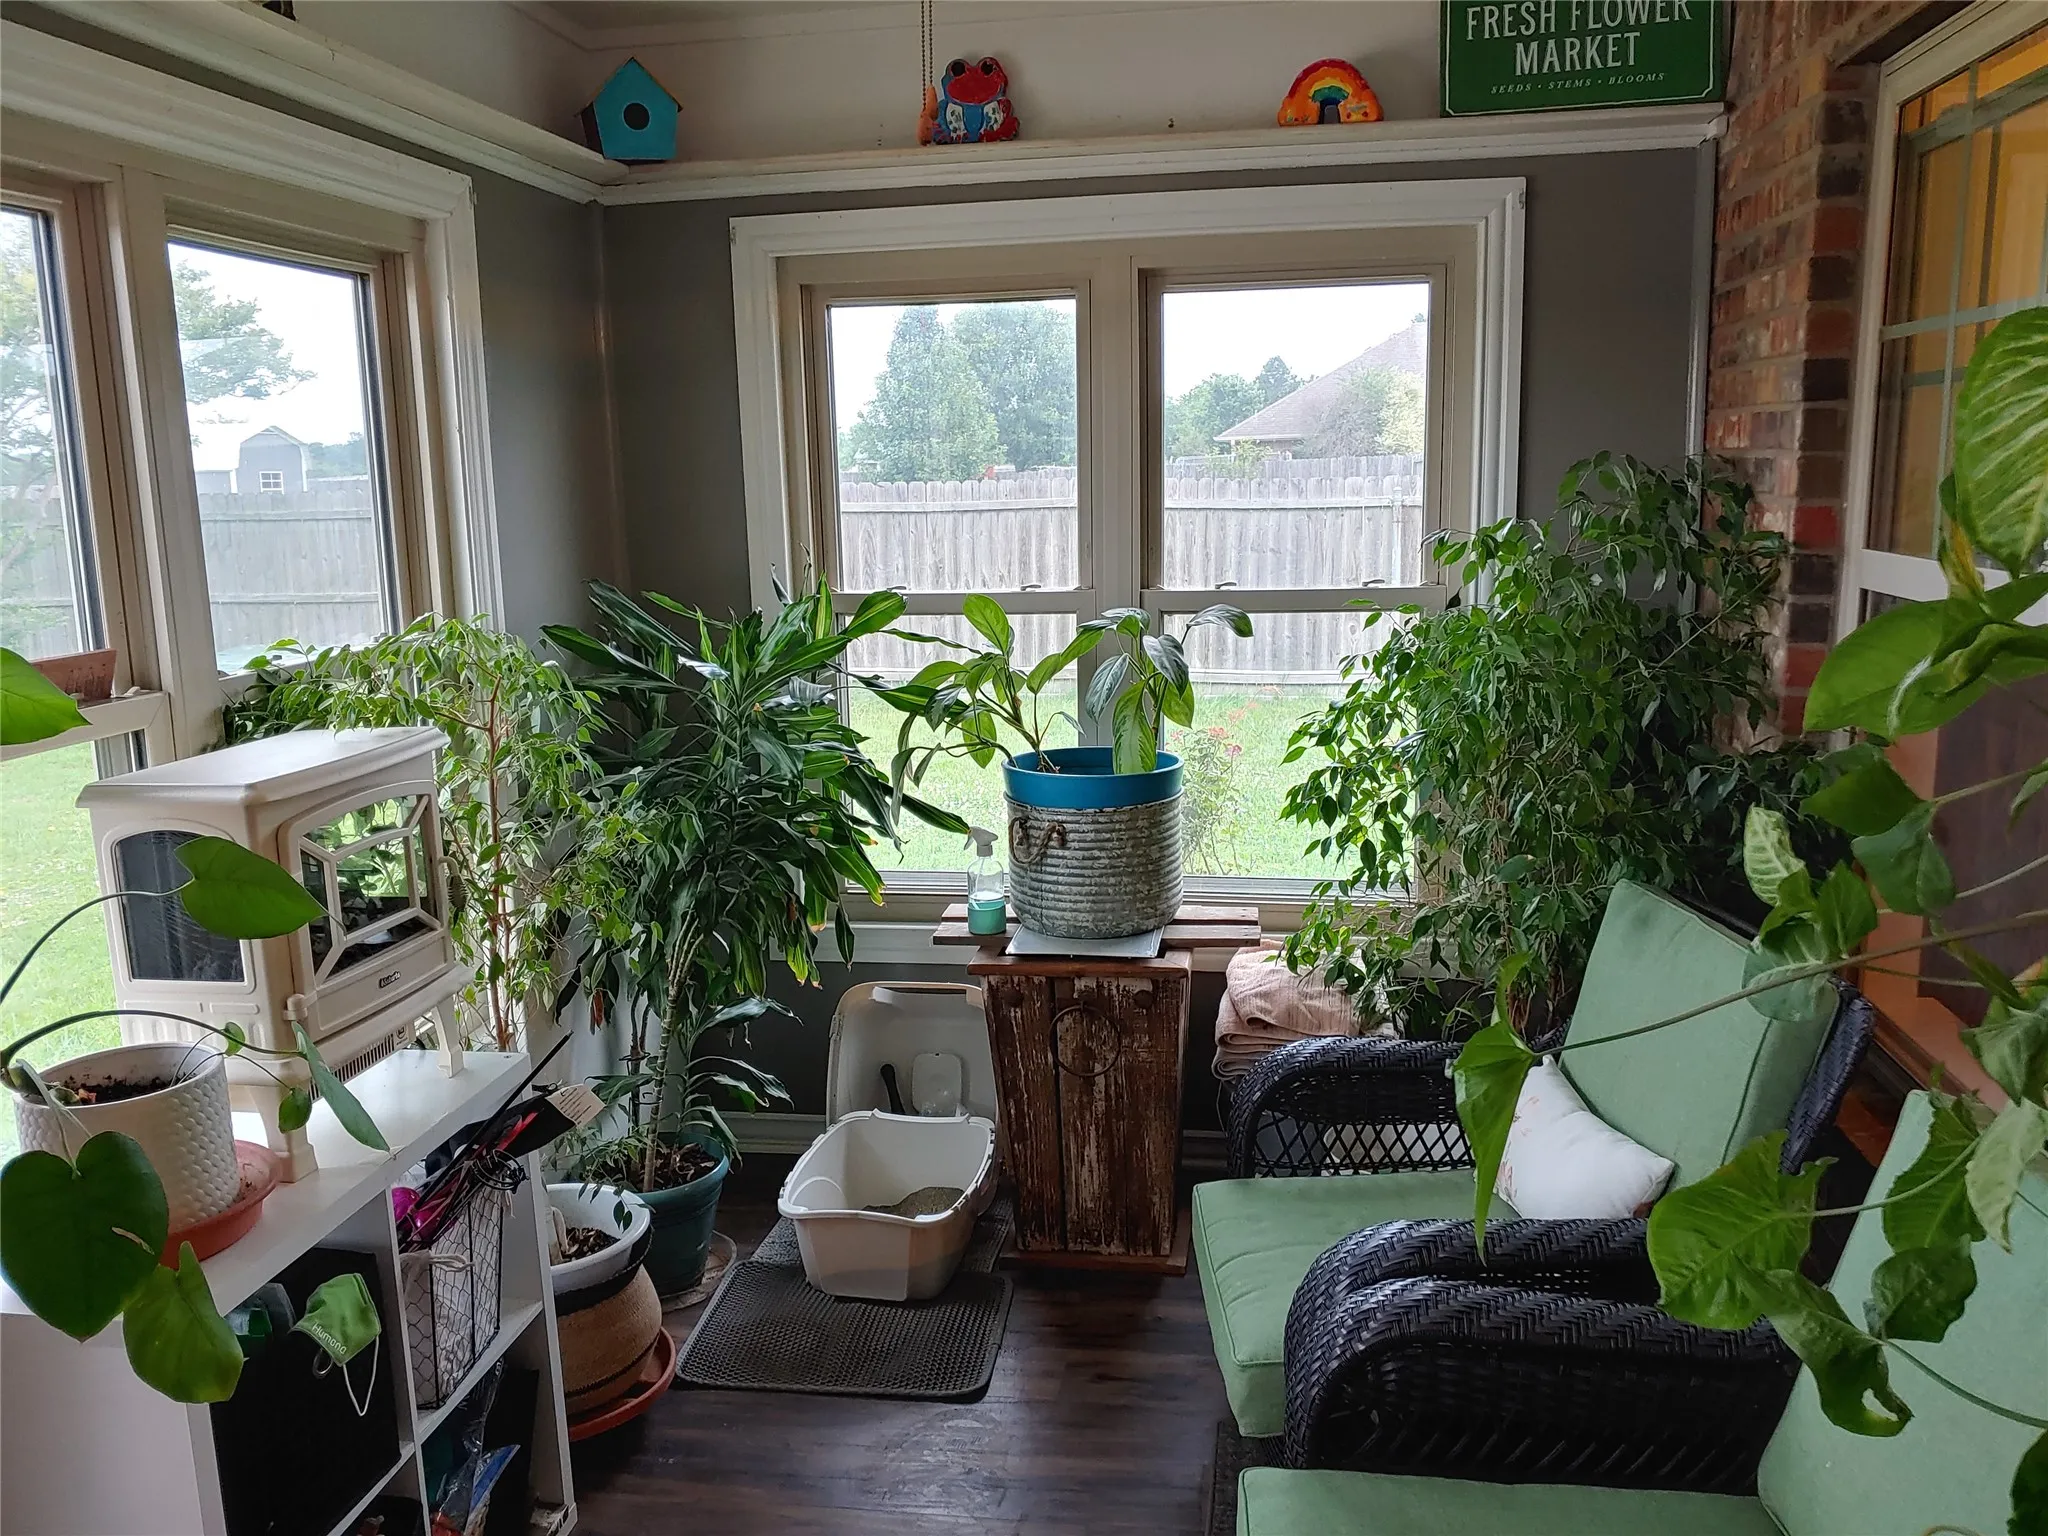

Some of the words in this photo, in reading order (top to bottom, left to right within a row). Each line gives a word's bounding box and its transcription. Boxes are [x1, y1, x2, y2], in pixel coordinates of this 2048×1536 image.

[1466, 0, 1557, 40] FRESH
[1570, 0, 1691, 31] FLOWER
[1515, 31, 1641, 76] MARKET
[1490, 83, 1532, 94] SEEDS
[1548, 78, 1592, 90] STEMS
[1608, 72, 1665, 85] BLOOMS
[311, 1321, 347, 1355] Humana
